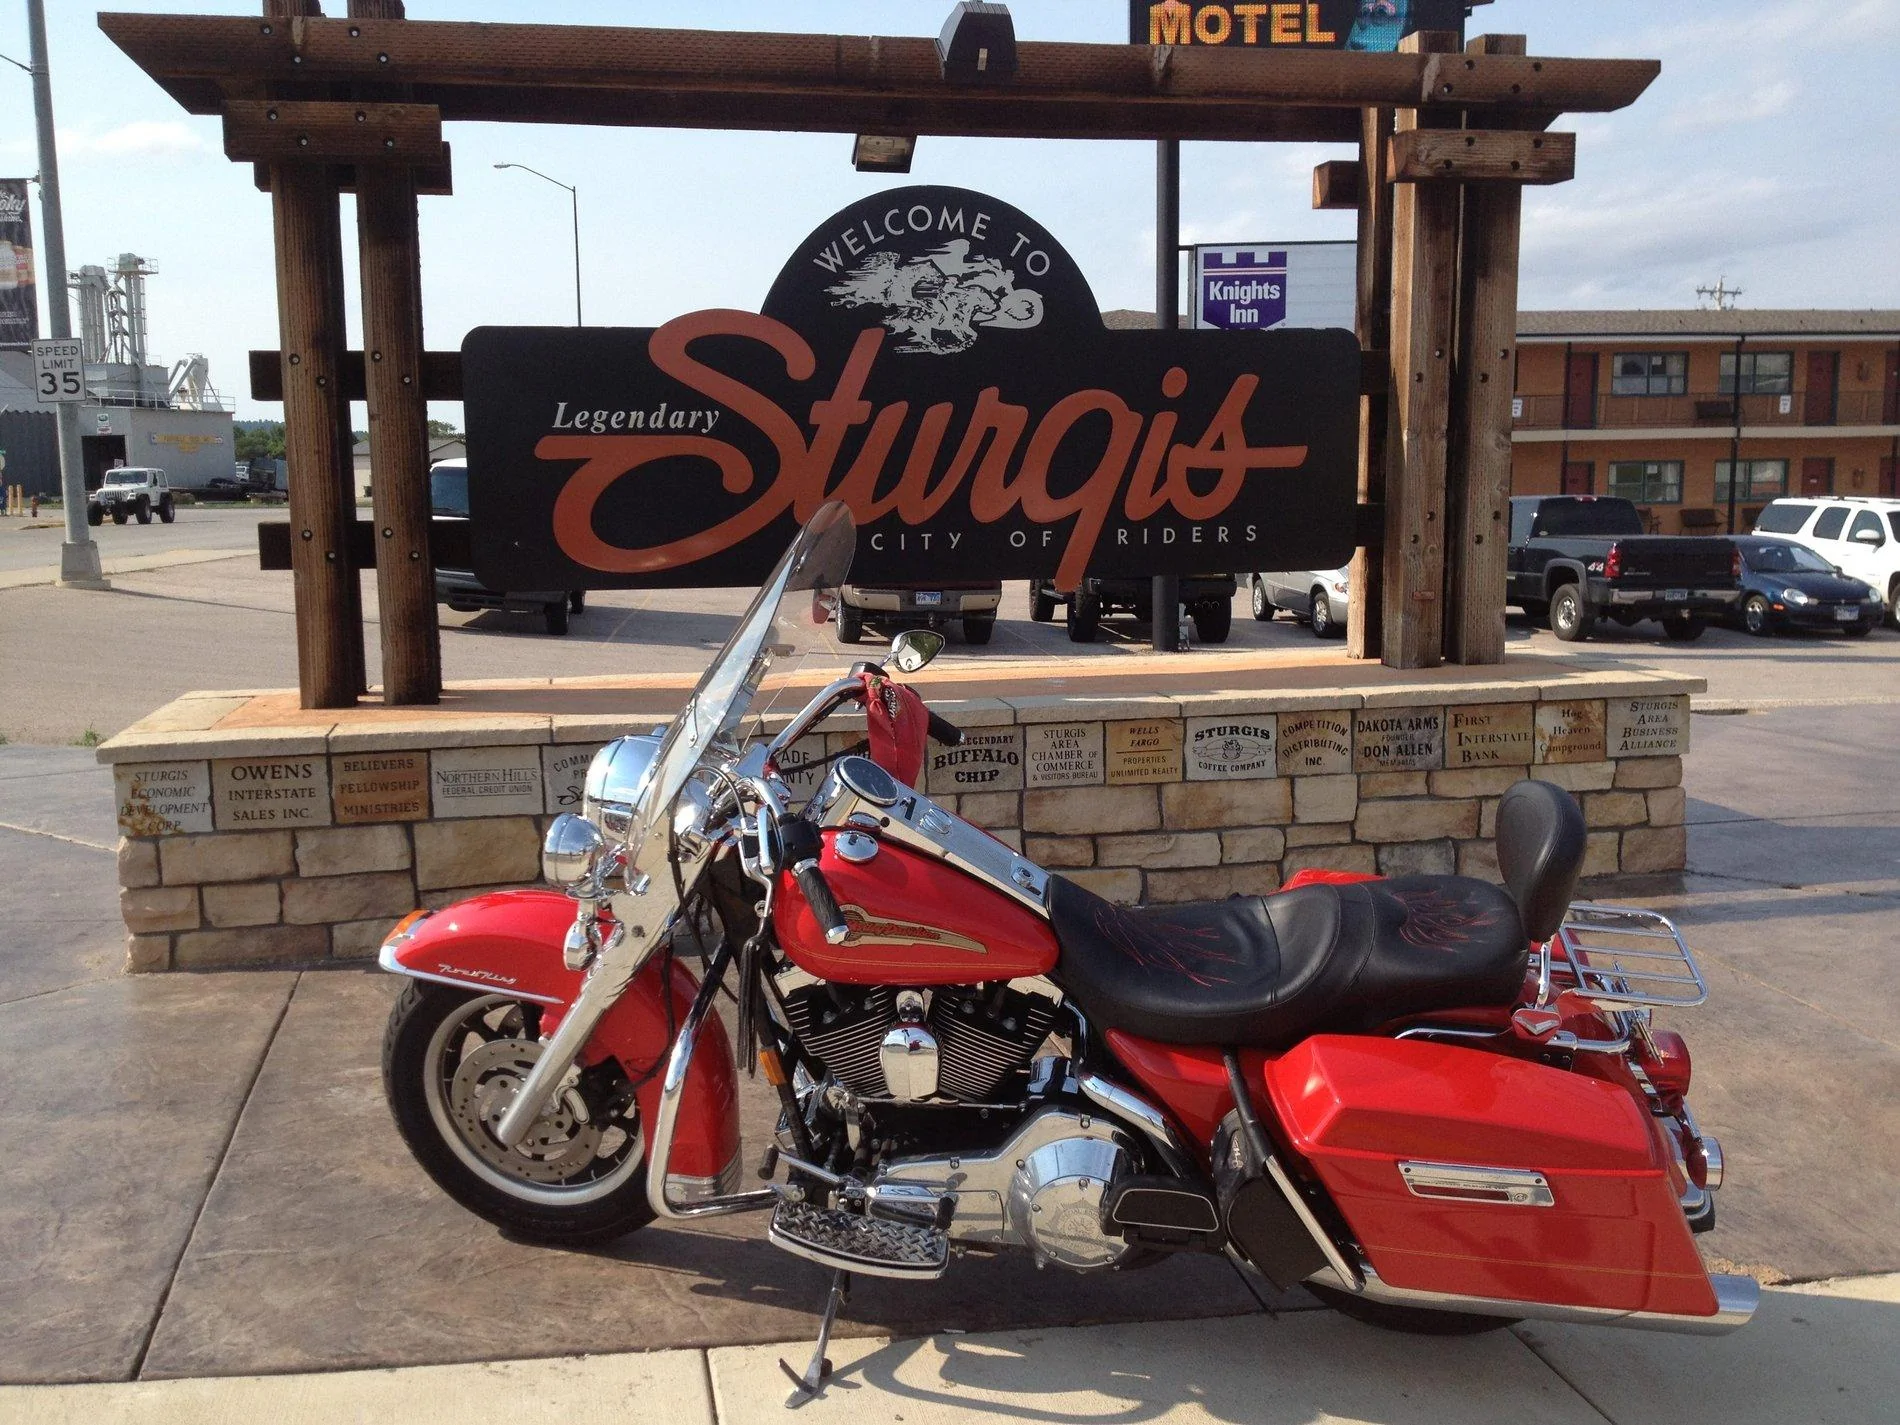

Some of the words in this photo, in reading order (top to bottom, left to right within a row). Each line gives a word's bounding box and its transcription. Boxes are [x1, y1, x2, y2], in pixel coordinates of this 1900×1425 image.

[1150, 1, 1335, 44] MOTEL
[813, 204, 991, 273] WELCOME
[1010, 232, 1050, 276] TO
[1209, 280, 1281, 305] Knights
[1229, 304, 1259, 323] Inn
[37, 346, 79, 357] SPEED
[42, 359, 74, 369] LIMIT
[40, 371, 81, 395] 35
[552, 402, 720, 434] Legendary
[533, 308, 1308, 592] Sturgis
[870, 532, 962, 551] CITY
[1009, 531, 1052, 548] OF
[1117, 525, 1257, 545] RIDERS
[1629, 701, 1679, 712] STURGIS
[1453, 713, 1493, 728] FIRST
[1561, 709, 1582, 721] Hog
[1637, 714, 1669, 725] AREA
[1129, 726, 1159, 735] WELLS
[1282, 719, 1348, 738] COMPETITION
[1357, 718, 1401, 733] DAKOTA
[1407, 717, 1439, 730] ARMS
[1553, 726, 1590, 735] Heaven
[1043, 728, 1086, 739] STURGIS
[1194, 725, 1271, 742] STURGIS
[1456, 731, 1531, 746] INTERSTATE
[1622, 727, 1678, 738] BUSINESS
[1051, 739, 1080, 749] AREA
[1130, 738, 1160, 747] FARGO
[1282, 738, 1349, 758] DISTRIBUTING
[1540, 741, 1601, 754] Campground
[1619, 739, 1677, 751] ALLIANCE
[1031, 750, 1083, 761] CHAMBER
[1364, 745, 1390, 758] DON
[1395, 743, 1433, 756] ALLEN
[1462, 750, 1500, 763] BANK
[343, 758, 414, 772] BELIEVERS
[553, 754, 593, 772] COMM
[933, 749, 1020, 771] BUFFALO
[1036, 760, 1094, 772] COMMERCE
[1123, 756, 1166, 765] PROPERTIES
[1198, 761, 1227, 772] COFFEE
[1230, 760, 1266, 772] COMPANY
[134, 770, 189, 783] STURGIS
[231, 763, 313, 781] OWENS
[436, 770, 500, 784] NORTHERN
[502, 768, 538, 782] HILLS
[954, 769, 1000, 783] CHIP
[1041, 773, 1070, 781] VISITORS
[1072, 771, 1098, 779] BUREAU
[1111, 768, 1149, 778] UNLIMITED
[1152, 767, 1178, 776] REALTY
[131, 786, 195, 800] ECONOMIC
[228, 787, 317, 801] INTERSTATE
[340, 780, 420, 794] FELLOWSHIP
[442, 786, 475, 795] FEDERAL
[479, 785, 506, 794] CREDIT
[508, 784, 533, 793] UNION
[120, 802, 209, 816] DEVELOPMENT
[233, 810, 275, 821] SALES
[344, 802, 420, 816] MINISTRIES
